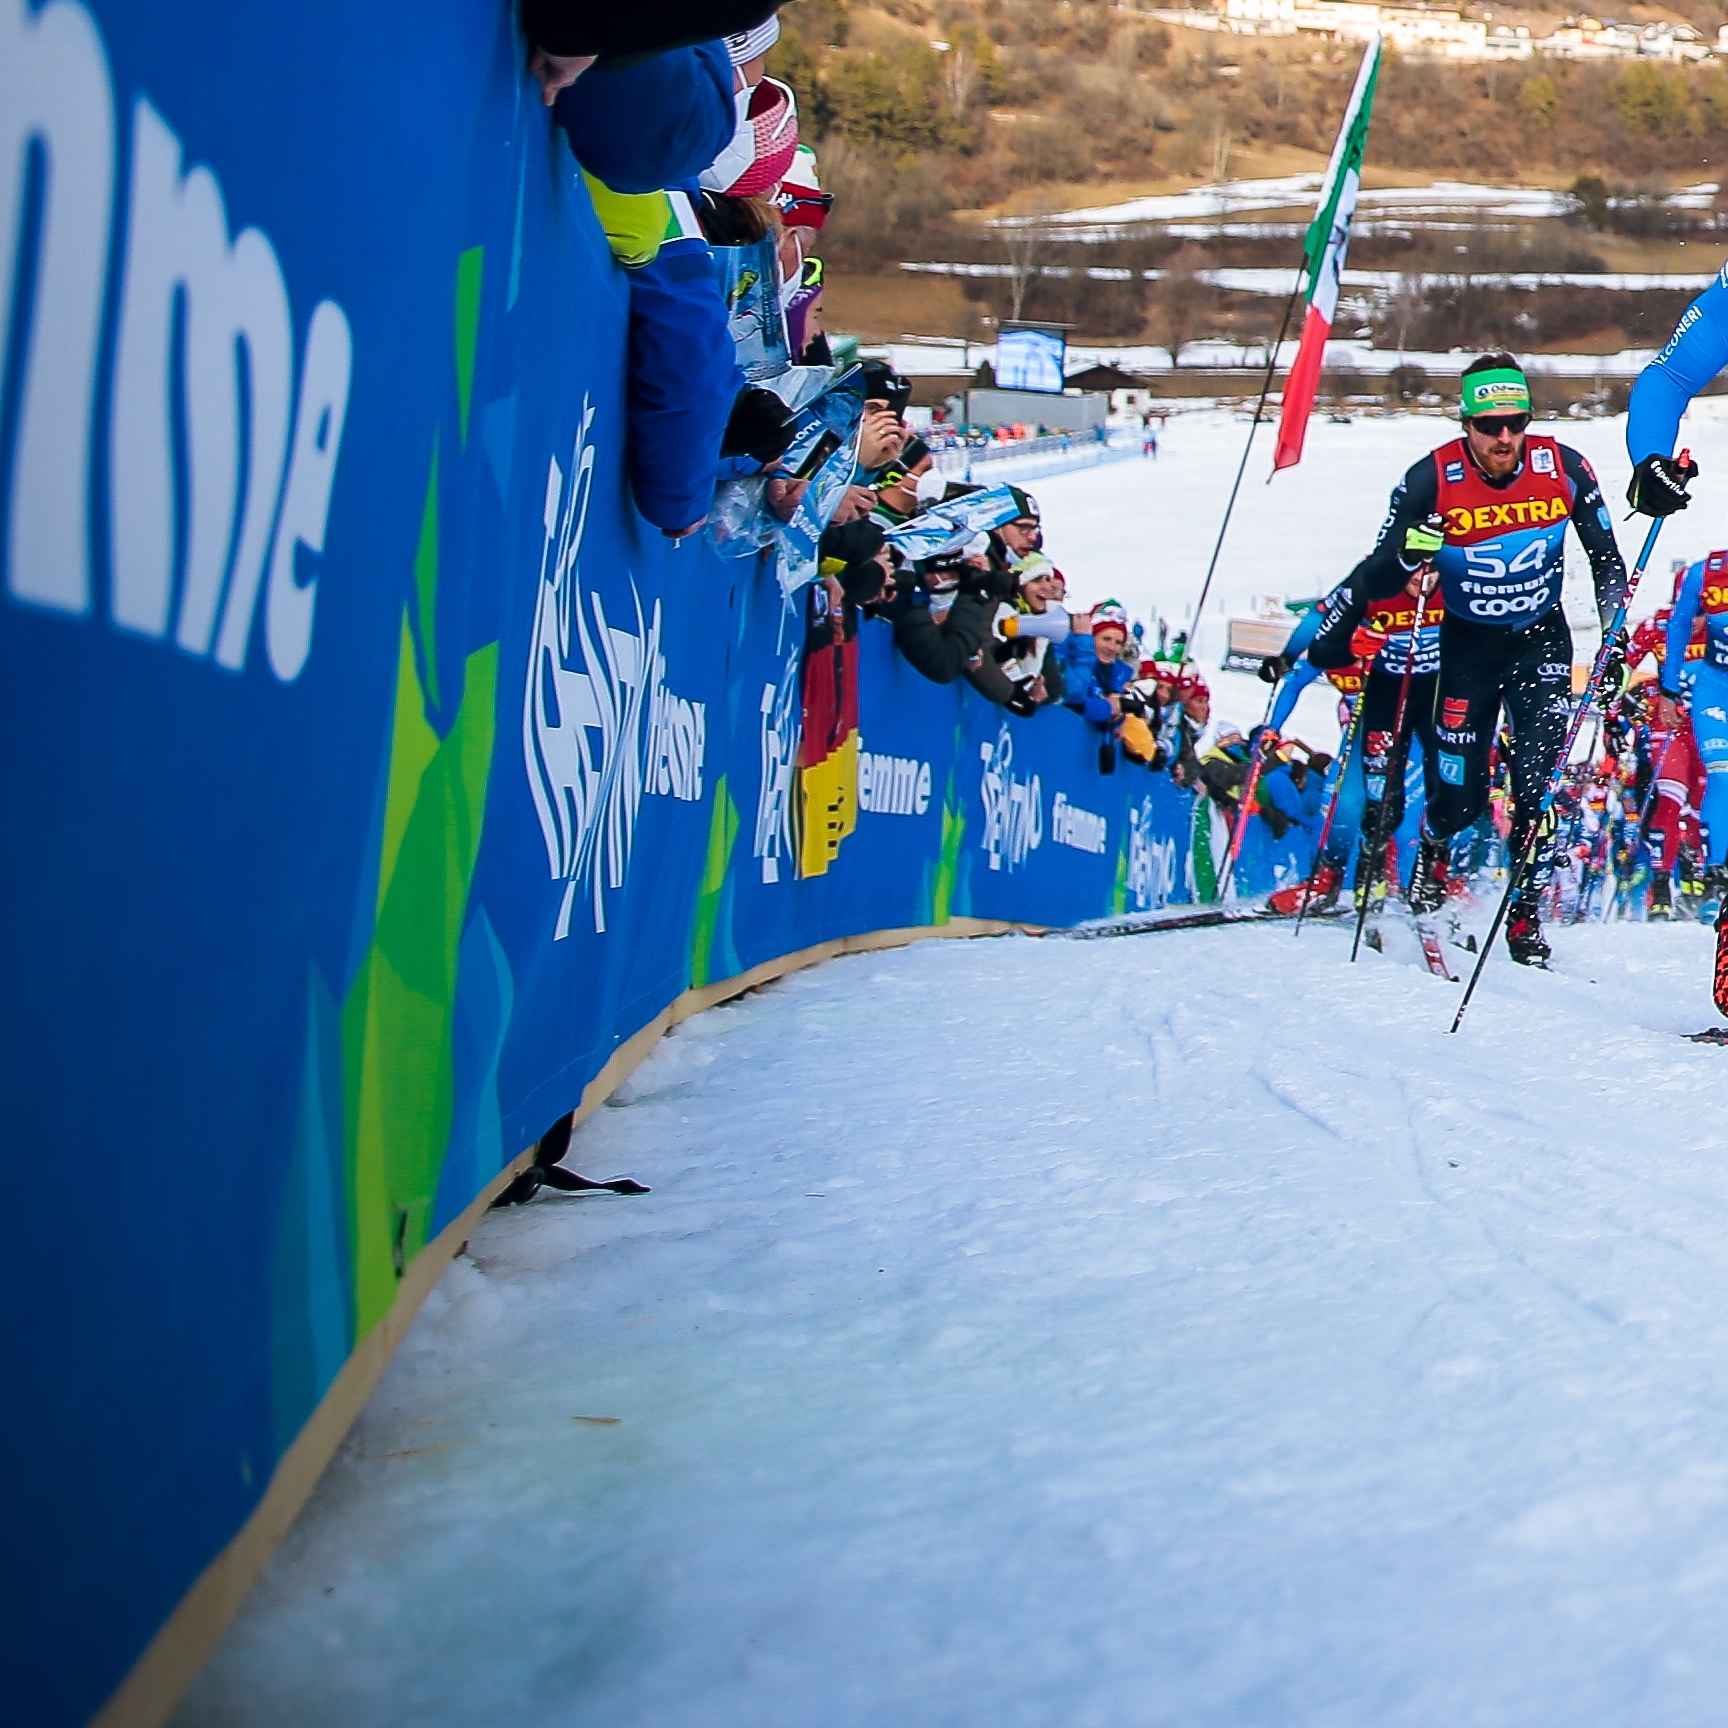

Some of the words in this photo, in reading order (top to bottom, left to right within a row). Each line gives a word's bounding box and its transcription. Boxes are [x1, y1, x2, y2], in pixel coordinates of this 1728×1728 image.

[1474, 497, 1570, 530] EXTRA
[1462, 538, 1548, 579] 54
[1469, 587, 1550, 616] coop
[857, 736, 932, 815] iemme
[1052, 790, 1107, 854] fiemme
